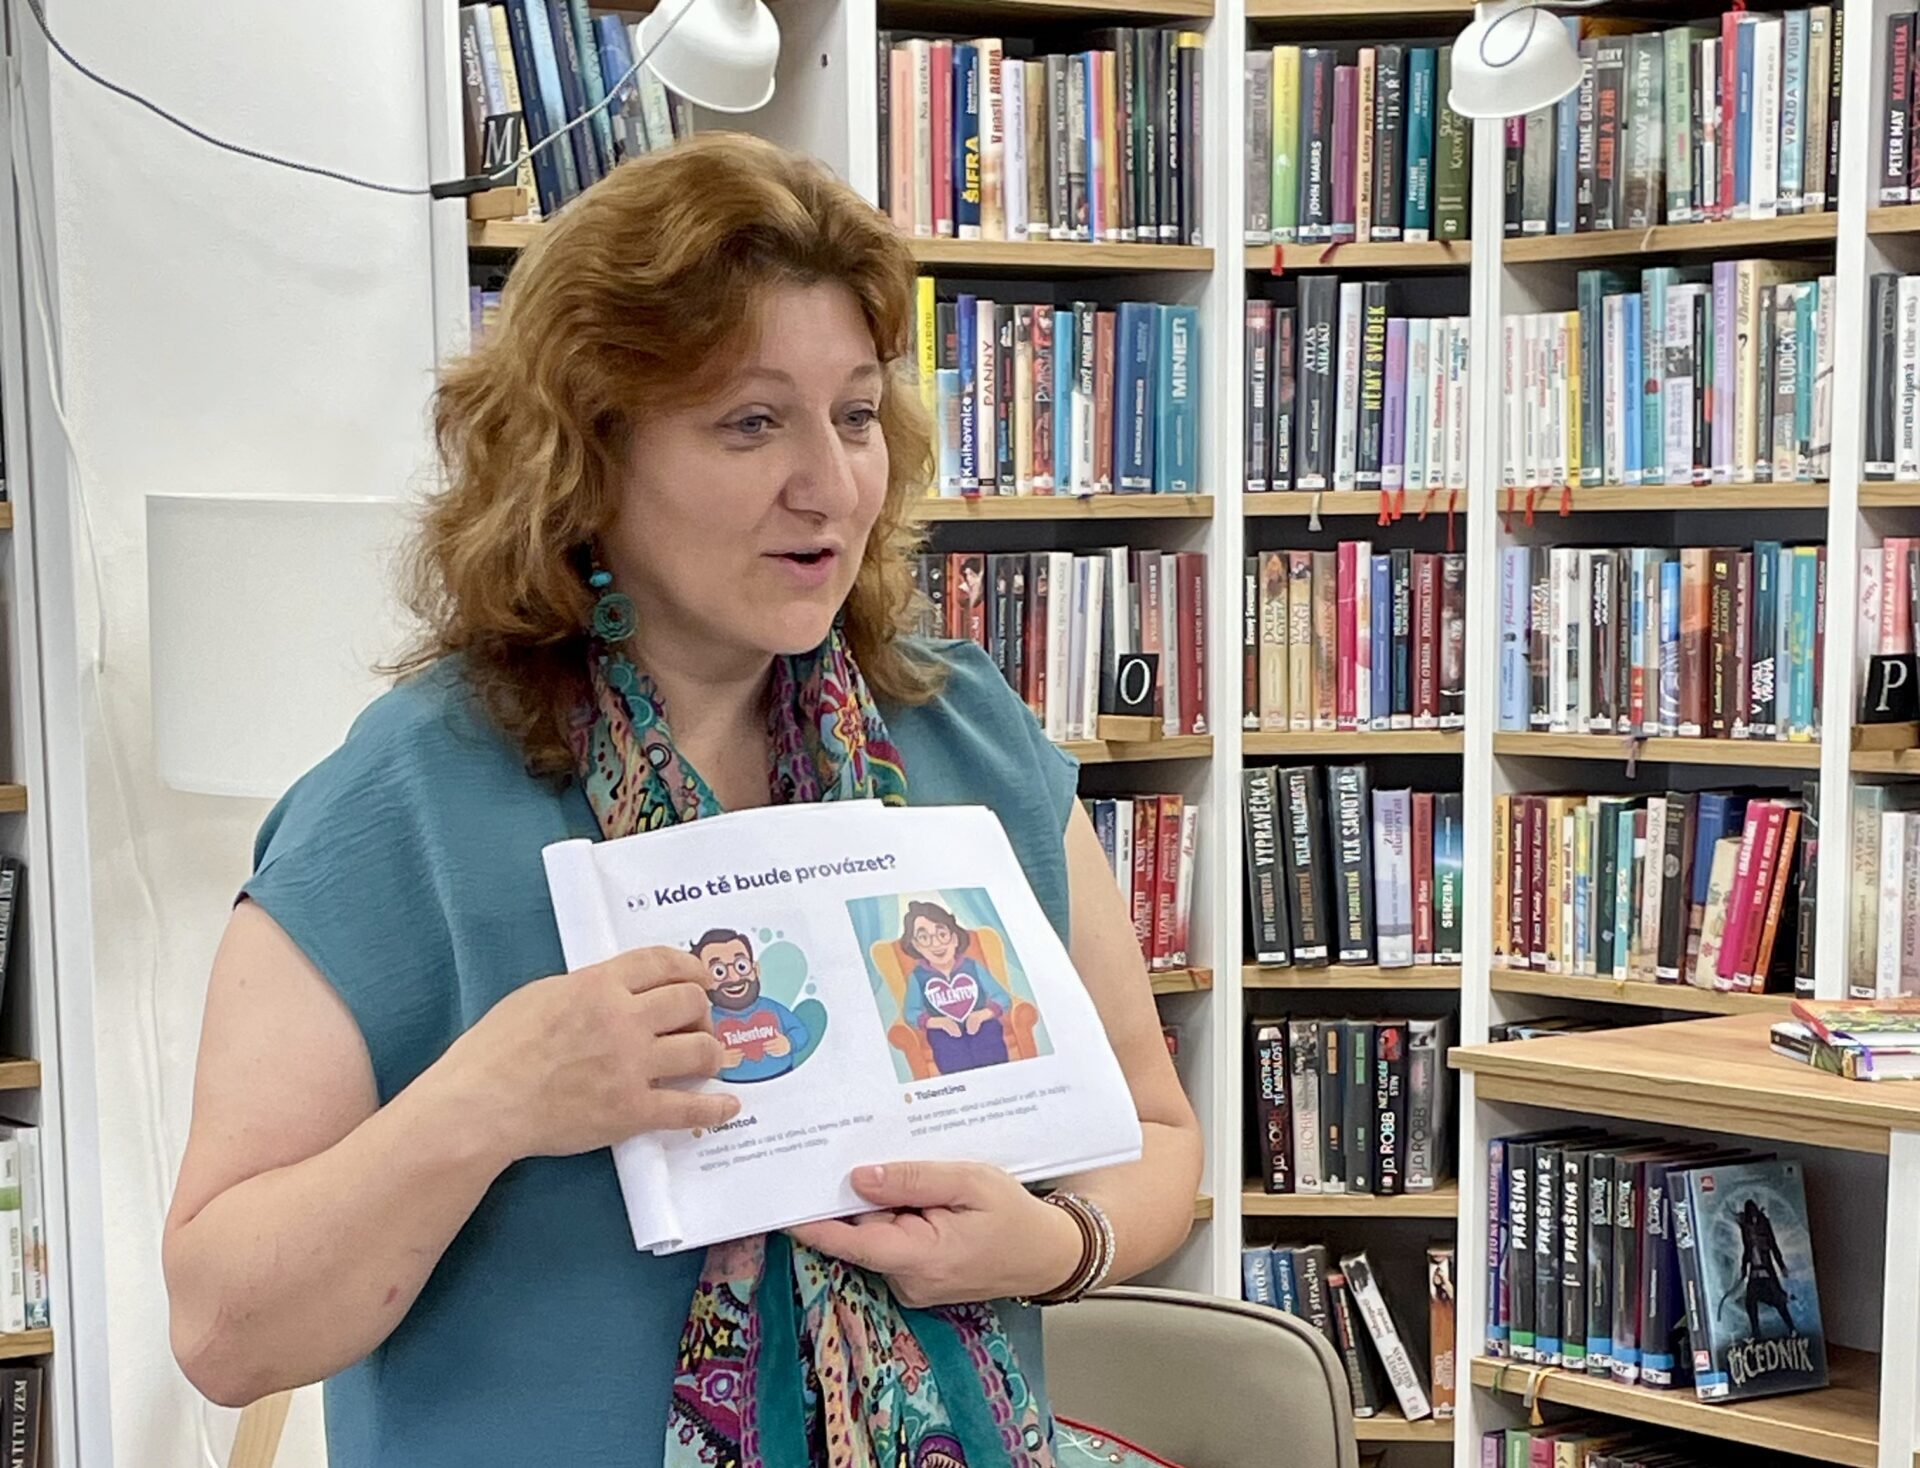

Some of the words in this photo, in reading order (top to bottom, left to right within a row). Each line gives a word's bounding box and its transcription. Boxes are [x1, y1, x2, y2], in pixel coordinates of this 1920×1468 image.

[989, 49, 1001, 94] ARABA
[1636, 50, 1651, 108] SESTRY
[1785, 64, 1797, 83] VE
[1892, 25, 1908, 100] KARANTÉNA
[1599, 122, 1615, 132] A
[1784, 89, 1797, 145] VRAŽDA
[1890, 110, 1905, 136] MAY
[483, 117, 515, 169] M
[1310, 140, 1322, 182] MARRS
[1579, 126, 1592, 170] TEMNÉ
[1633, 113, 1648, 177] KRVAVÉ
[1889, 137, 1903, 176] PETER
[960, 136, 979, 203] ŠIFRA
[1309, 183, 1322, 216] JOHN
[1738, 272, 1750, 325] Sherlock
[1082, 312, 1093, 333] NOC
[1364, 306, 1385, 362] SVĚDEK
[1172, 317, 1187, 398] MINIER
[1304, 328, 1316, 371] ATLAS
[1317, 323, 1330, 375] MRAKŮ
[1776, 327, 1796, 394] BLUDIČKY
[983, 340, 993, 406] PANNY
[1080, 368, 1093, 394] KDYŽ
[1344, 375, 1354, 410] POKOJ
[1362, 368, 1382, 410] NĚMÝ
[1136, 379, 1144, 415] MINIER
[1149, 565, 1157, 606] BRENDA
[1263, 595, 1274, 643] DCERA
[1119, 658, 1151, 706] O
[1420, 678, 1430, 704] KEVIN
[1751, 662, 1762, 700] MYSLI
[1760, 657, 1774, 702] VRAHA
[1875, 660, 1907, 711] P
[1751, 704, 1762, 715] V
[1249, 777, 1274, 866] VYPRAVĚČKA
[1289, 775, 1308, 834] MALIČKOSTI
[1337, 775, 1359, 835] SAMOTÁŘ
[1381, 808, 1394, 845] Zimní
[1393, 798, 1404, 856] slunovrat
[1291, 836, 1311, 866] VELKÉ
[1341, 838, 1361, 863] VLK
[654, 884, 701, 906] Kdo
[705, 875, 732, 896] tě
[734, 868, 792, 891] bude
[795, 853, 896, 884] provázet?
[1258, 872, 1275, 922] PICOULTOVÁ
[1295, 872, 1313, 921] PICOULTOVÁ
[1344, 871, 1361, 921] PICOULTOVÁ
[1159, 893, 1171, 944] ELIZABETH
[1263, 924, 1276, 941] JODI
[1350, 923, 1362, 940] JODI
[723, 1025, 774, 1045] Talentov
[1259, 1048, 1273, 1099] DOSTIHNE
[1271, 1041, 1284, 1092] MINULOST
[915, 1084, 967, 1100] Talentina
[1378, 1090, 1388, 1109] NEŽ
[1269, 1110, 1283, 1151] ROBB
[1300, 1112, 1314, 1150] ROBB
[1381, 1111, 1396, 1154] ROBB
[1411, 1107, 1427, 1152] ROBB
[1274, 1152, 1288, 1170] J.D.
[1384, 1156, 1397, 1174] J.D.
[1413, 1155, 1427, 1171] J.D.
[1565, 1162, 1578, 1174] 3
[1510, 1168, 1528, 1250] PRAŠINA
[1535, 1172, 1552, 1255] PRAŠINA
[1560, 1182, 1578, 1263] PRAŠINA
[1302, 1257, 1320, 1310] strachu
[14, 1380, 27, 1411] ZEM
[12, 1416, 25, 1436] TU
[12, 1440, 25, 1455] TI
